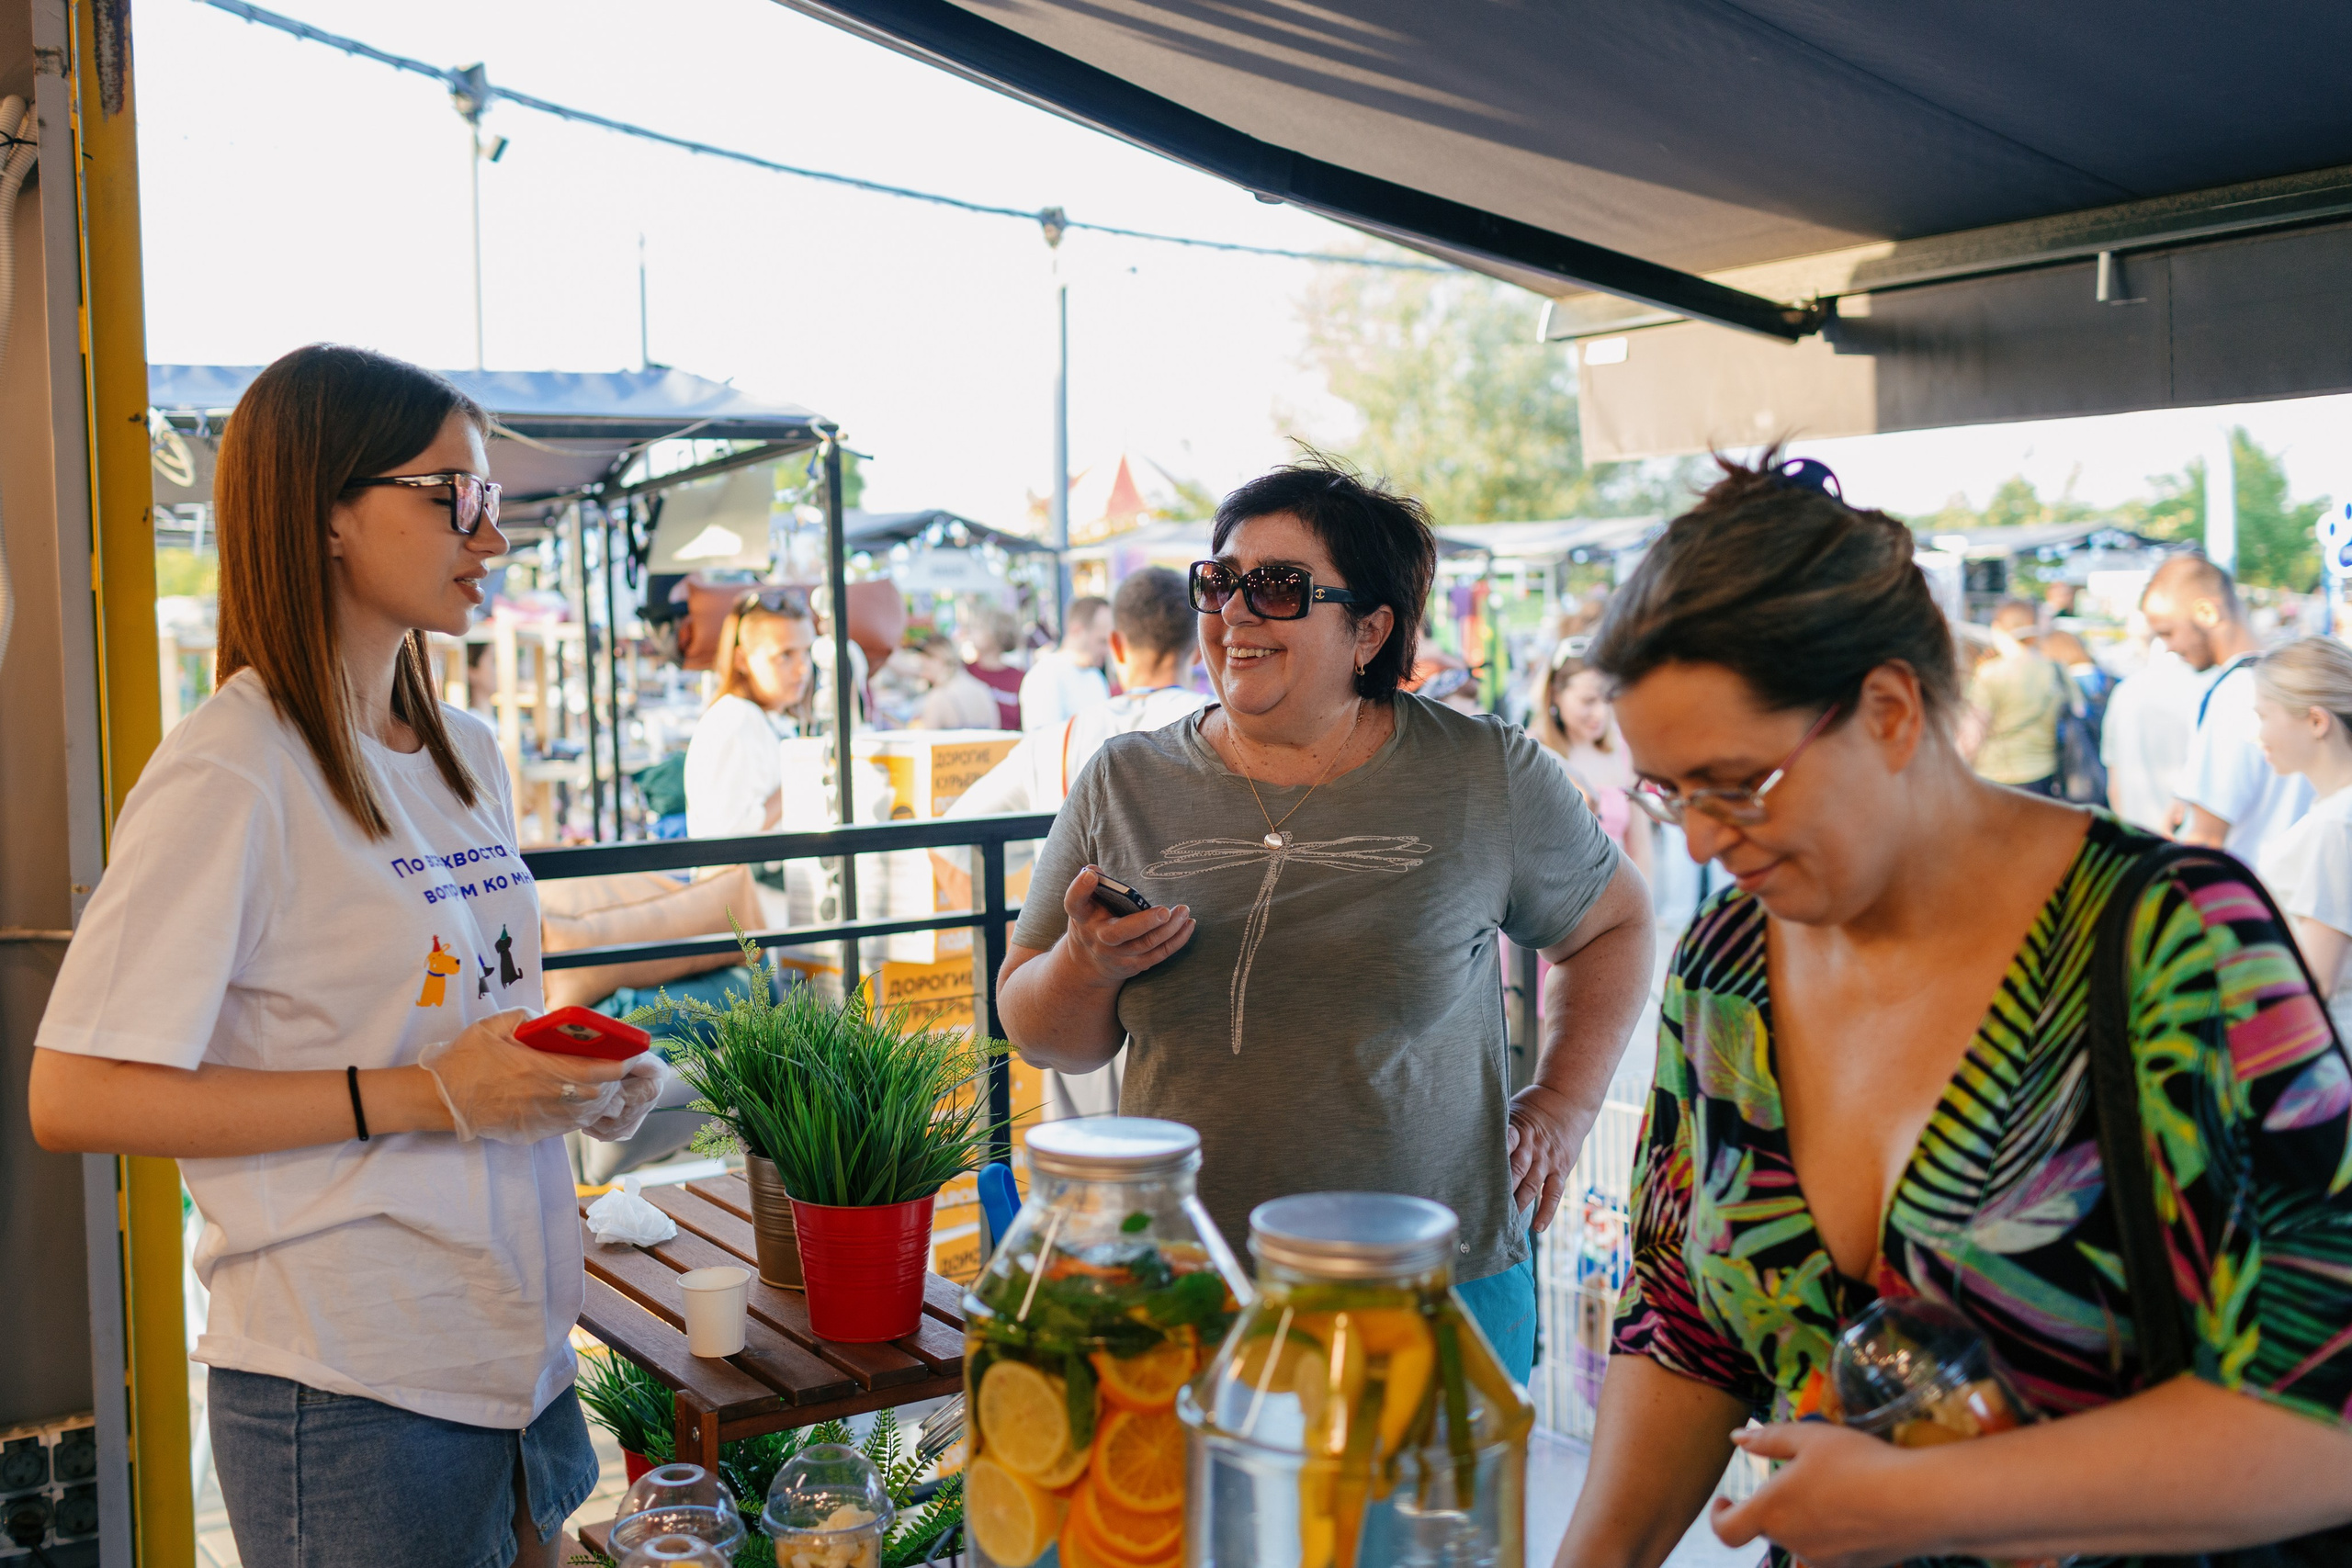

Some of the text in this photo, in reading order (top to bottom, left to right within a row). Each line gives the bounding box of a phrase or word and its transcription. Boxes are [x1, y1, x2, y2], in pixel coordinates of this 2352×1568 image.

[390, 857, 425, 879] По
[482, 874, 509, 894] ко
[511, 871, 536, 886] мн
